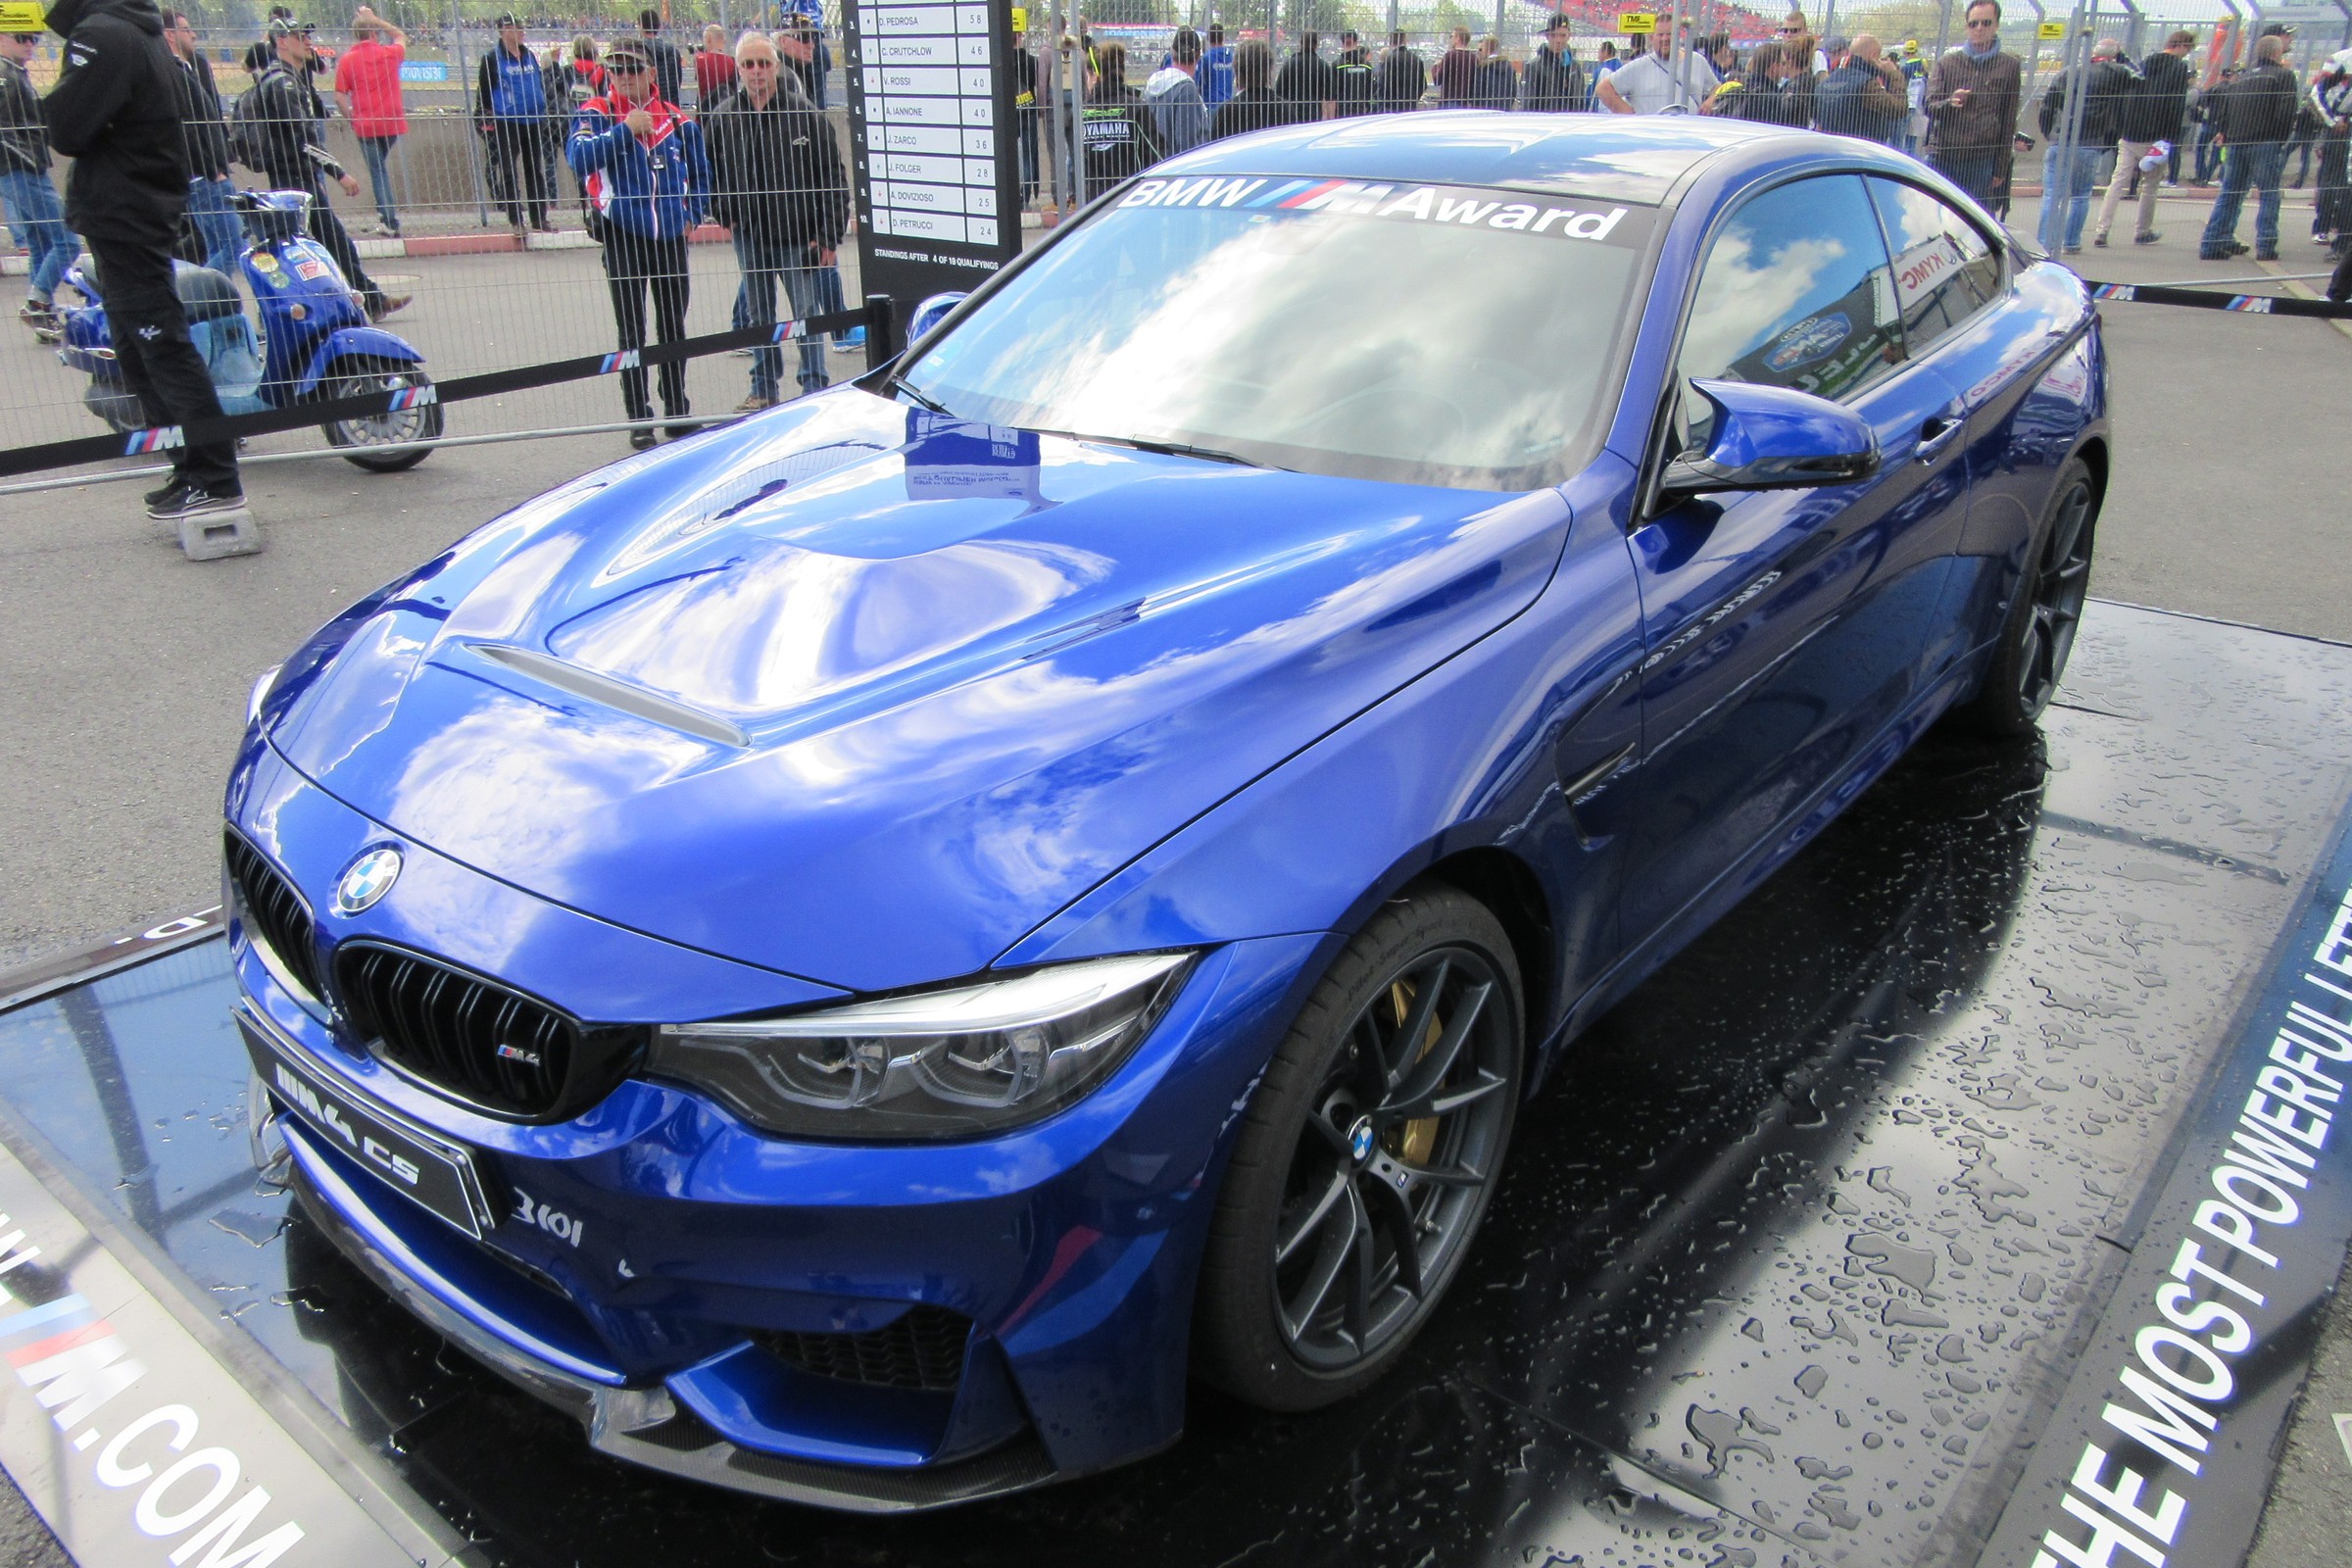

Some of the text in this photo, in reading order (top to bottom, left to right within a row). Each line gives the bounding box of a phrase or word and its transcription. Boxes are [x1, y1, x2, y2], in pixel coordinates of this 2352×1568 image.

[886, 17, 919, 25] PEDROSA
[889, 47, 933, 56] CRUTCHLOW
[890, 77, 911, 86] ROSSI
[1086, 122, 1130, 135] YAMAHA
[894, 136, 917, 145] ZARCO
[896, 165, 921, 173] FOLGER
[898, 192, 934, 202] DOVIZIOSO
[1115, 178, 1272, 208] BMW
[1377, 187, 1628, 241] Award
[900, 220, 933, 229] PETRUCCI
[874, 249, 908, 261] STANDINGS
[908, 252, 929, 263] AFTER
[939, 256, 948, 265] OF
[956, 257, 1000, 270] QUALIFYINGS
[364, 1136, 420, 1186] CS
[2030, 1001, 2352, 1568] HE MOST POWERFUL
